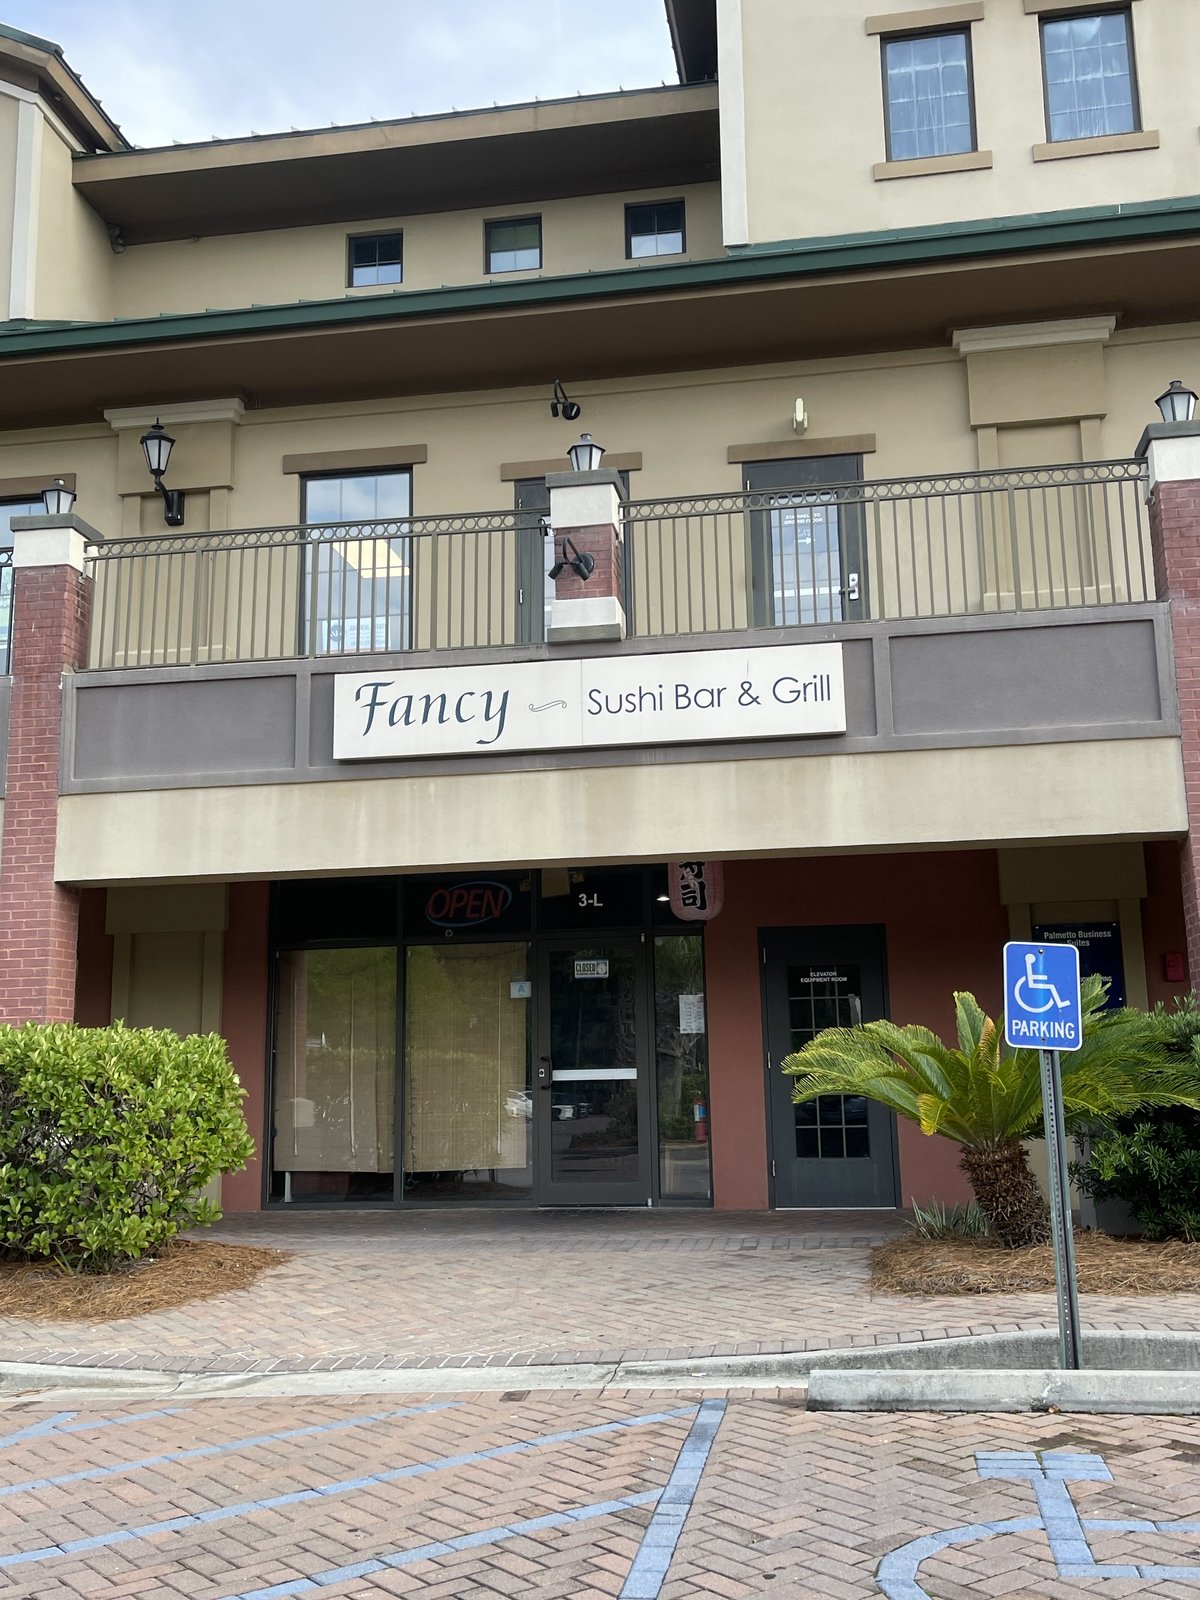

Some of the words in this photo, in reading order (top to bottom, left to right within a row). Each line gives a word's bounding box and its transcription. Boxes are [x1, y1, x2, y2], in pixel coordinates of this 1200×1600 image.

[354, 680, 510, 745] Fancy
[587, 683, 664, 716] Sushi
[675, 682, 727, 710] Bar
[737, 680, 760, 706] &
[772, 674, 832, 704] Grill
[427, 888, 505, 919] OPEN
[578, 893, 603, 907] 3-L
[1043, 931, 1077, 940] Palmetto
[1078, 930, 1112, 939] Business
[575, 962, 596, 973] CLOSED
[1011, 1019, 1075, 1040] PARKING
